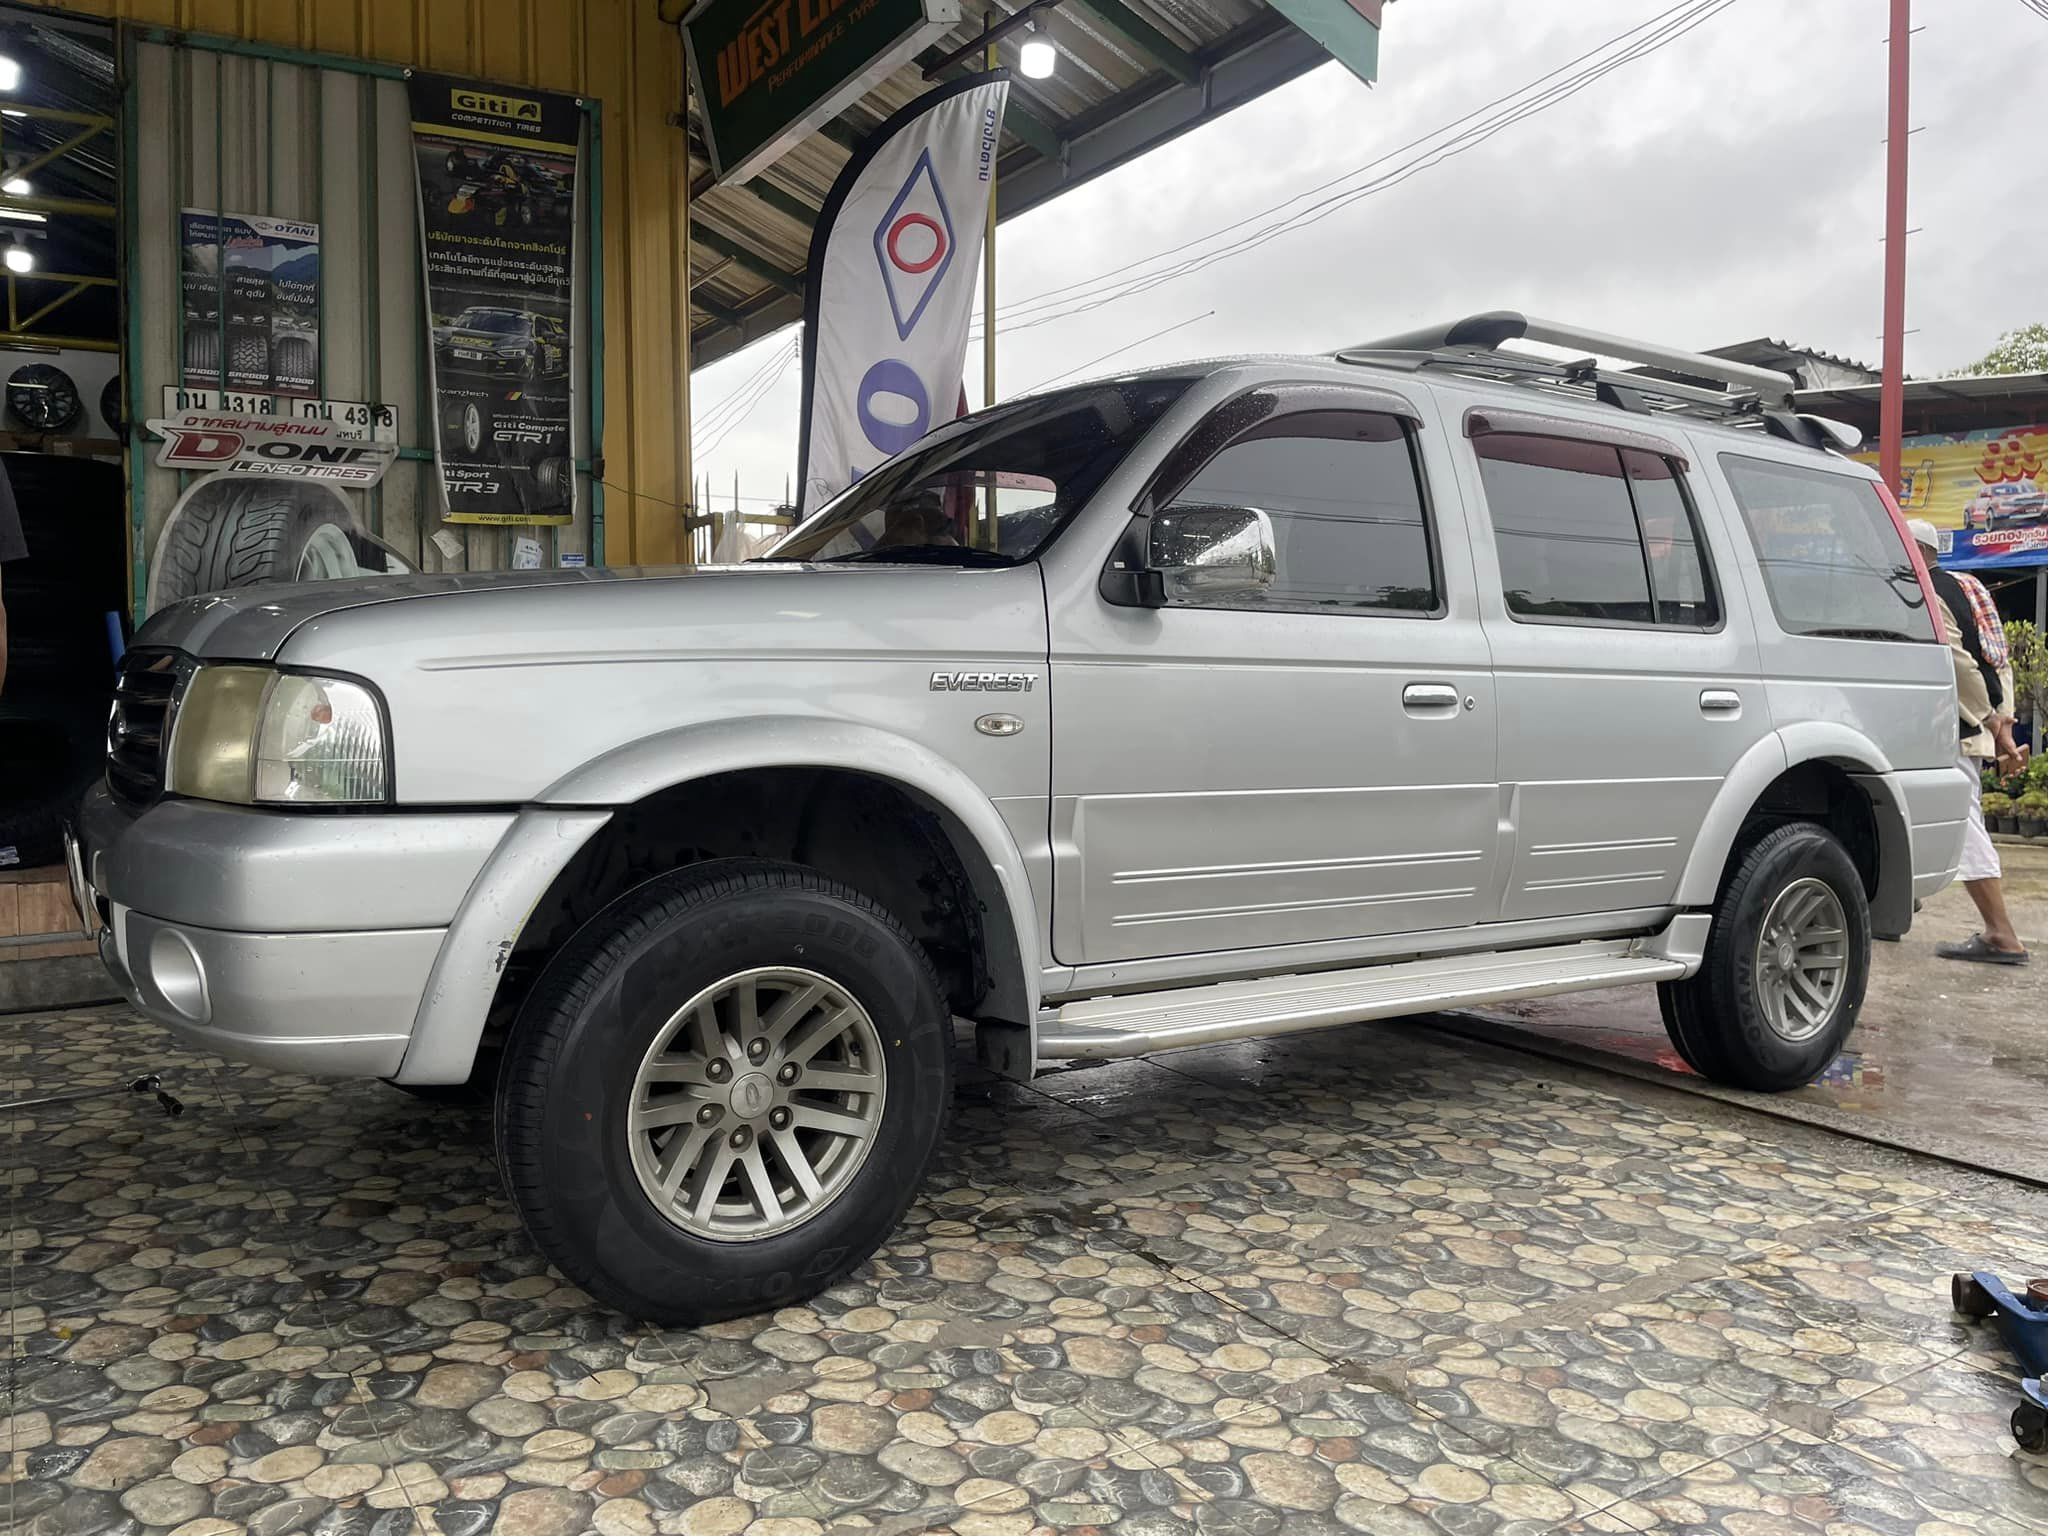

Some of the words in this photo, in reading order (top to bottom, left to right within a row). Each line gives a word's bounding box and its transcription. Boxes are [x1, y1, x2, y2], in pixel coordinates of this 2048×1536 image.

[457, 94, 508, 114] Giti
[451, 112, 512, 129] COMPETITION
[516, 122, 542, 134] TIRES
[275, 224, 315, 237] OTANI
[493, 420, 517, 430] Giti
[518, 422, 566, 433] Compete
[233, 461, 306, 476] LENSO
[310, 465, 376, 480] TIRES
[456, 469, 490, 480] Sport
[929, 671, 1039, 692] EVEREST
